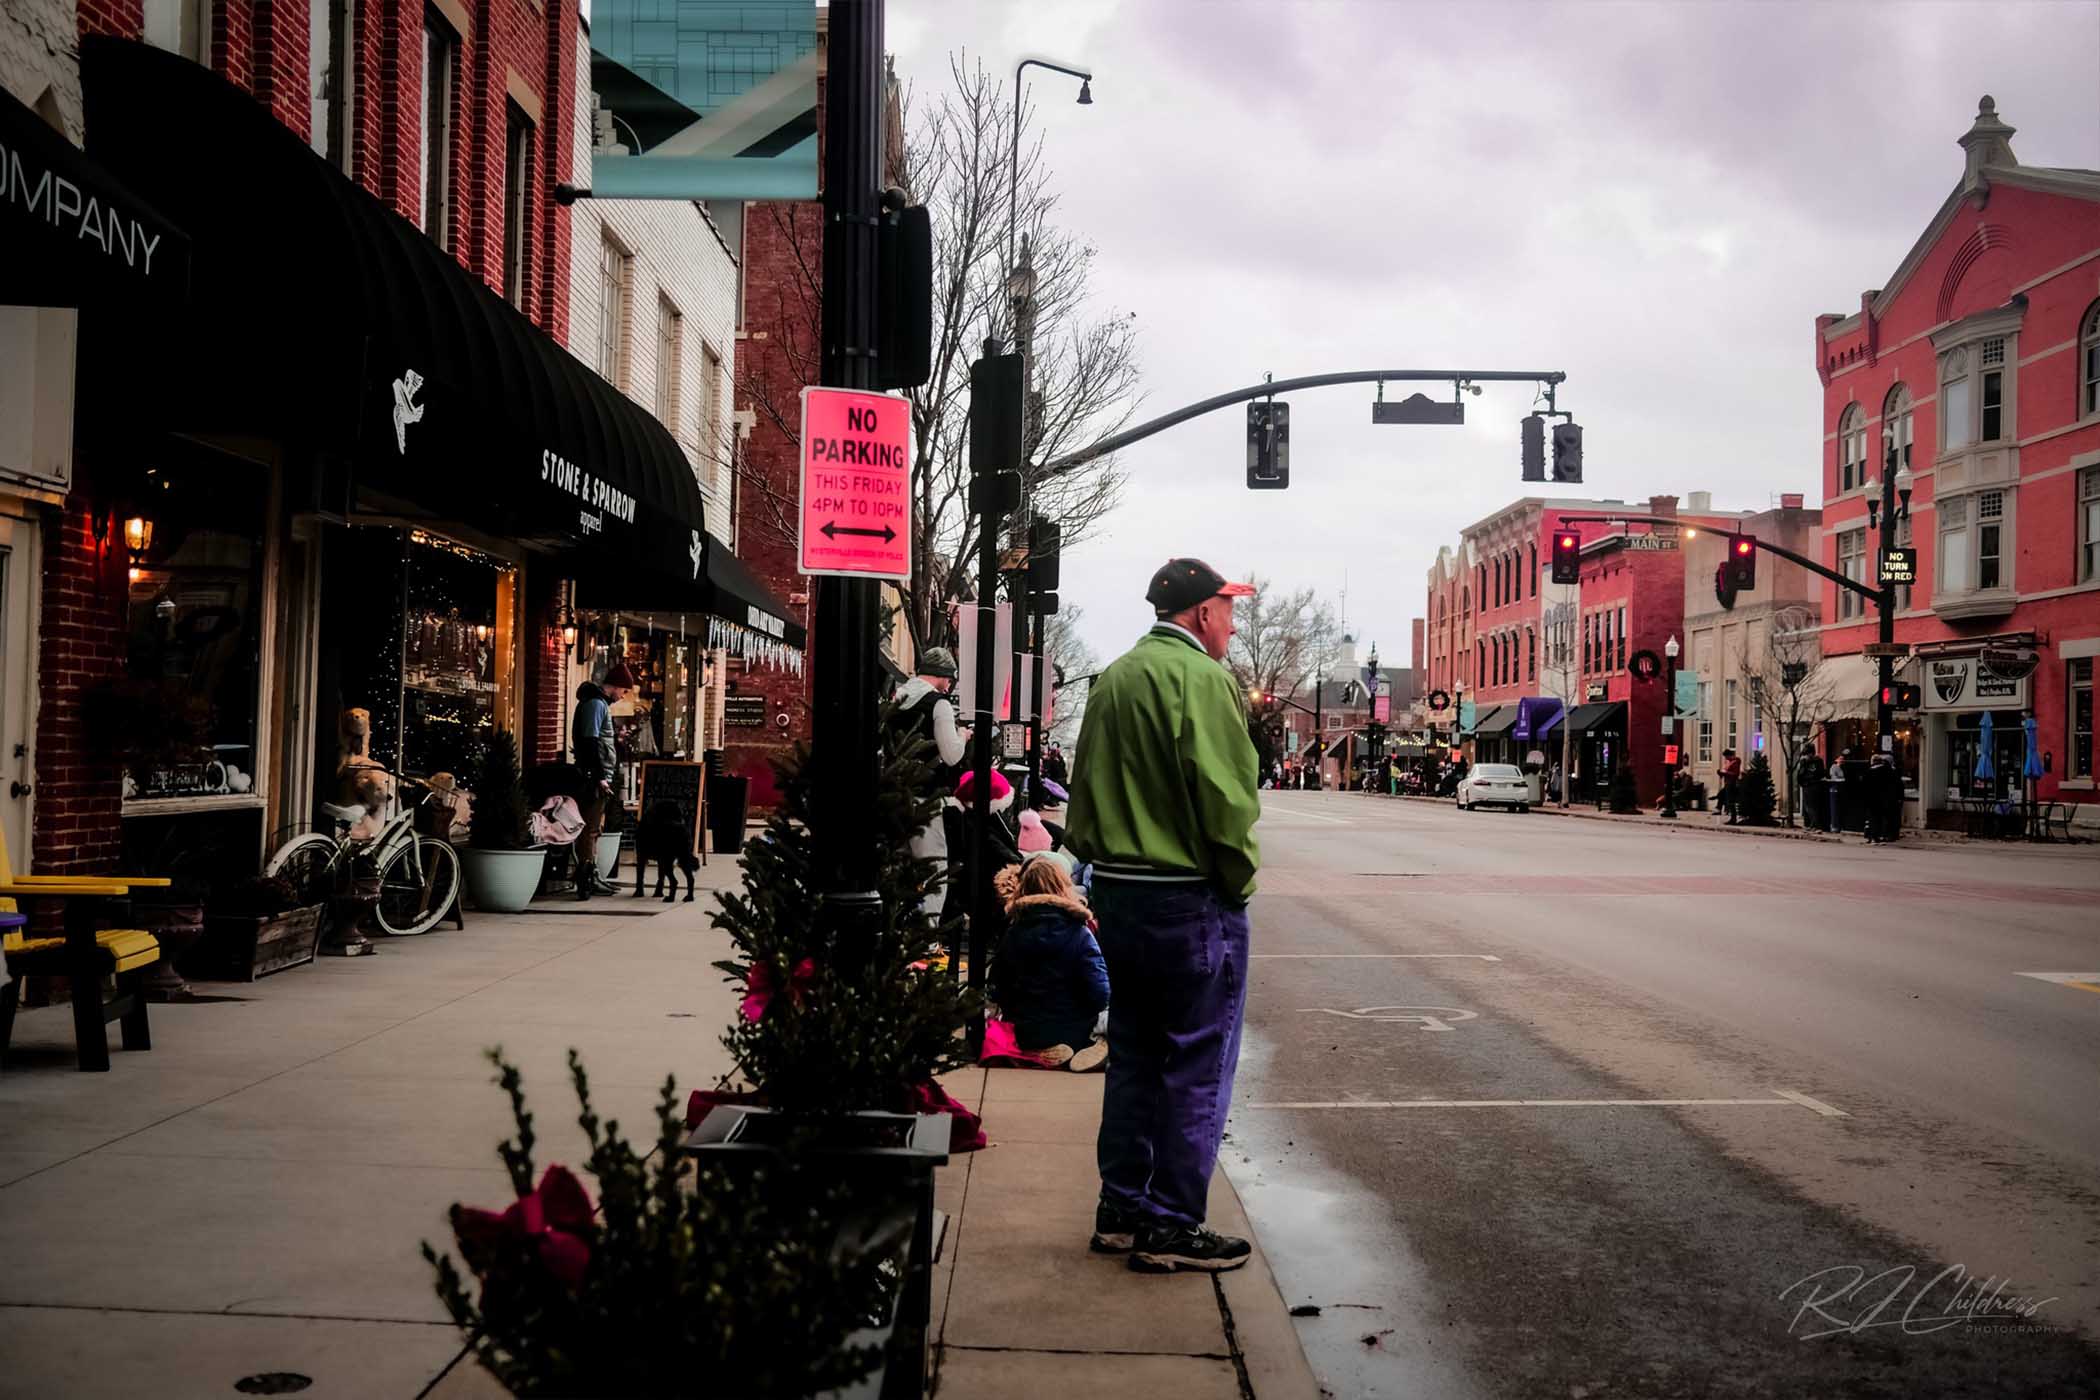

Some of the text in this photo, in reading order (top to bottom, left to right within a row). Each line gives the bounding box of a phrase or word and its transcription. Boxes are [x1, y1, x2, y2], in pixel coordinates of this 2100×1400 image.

[0, 143, 161, 275] MPANY
[848, 407, 877, 433] NO
[812, 437, 904, 469] PARKING
[541, 448, 636, 525] STONE & SPARROW
[815, 474, 902, 496] THIS FRIDAY
[812, 497, 903, 518] 4PM TO 10PM
[1630, 538, 1672, 550] MAIN ST
[1884, 562, 1909, 571] TURN
[1889, 552, 1904, 561] NO
[1881, 572, 1913, 580] ON RED
